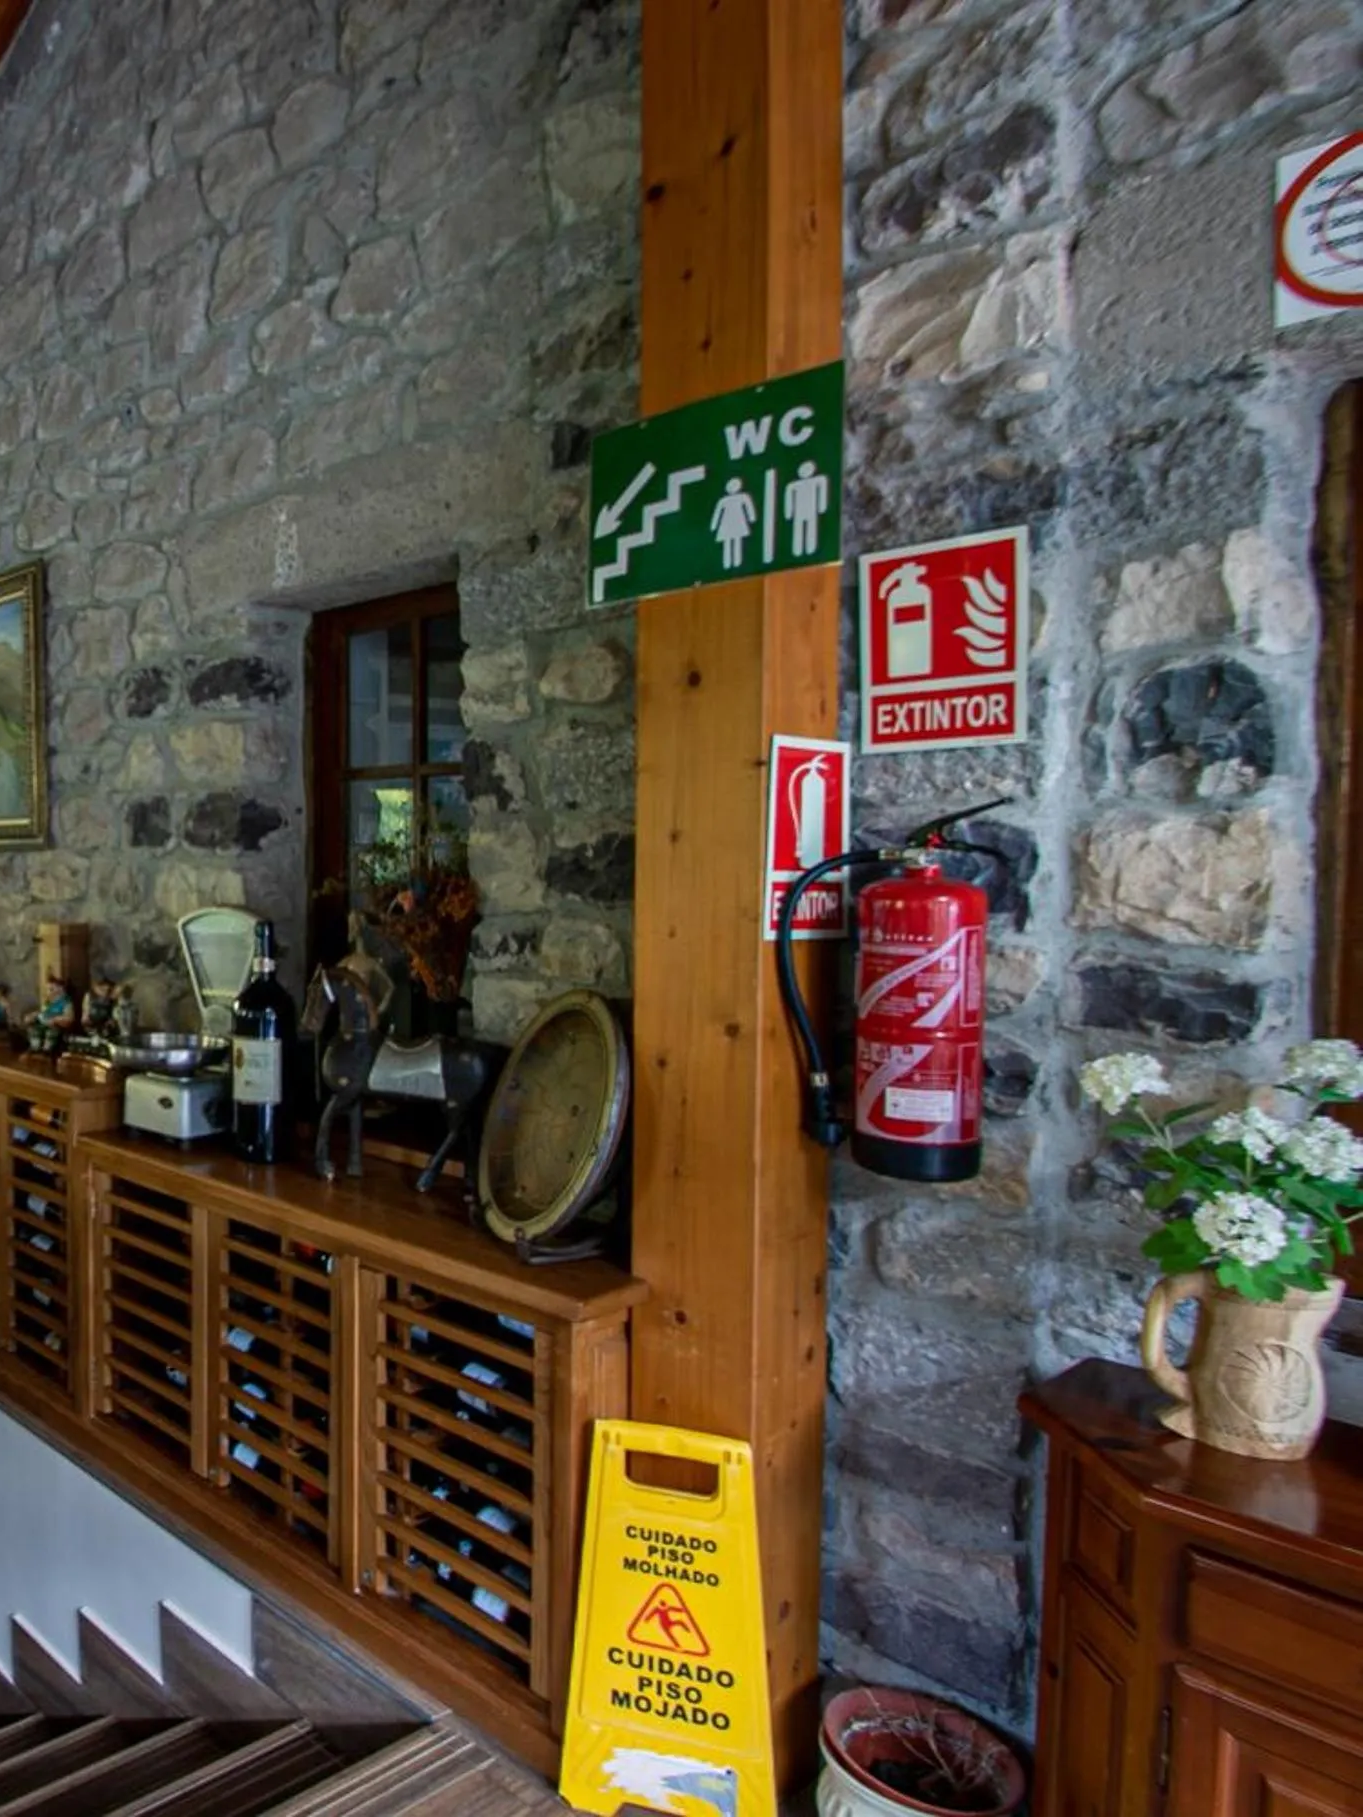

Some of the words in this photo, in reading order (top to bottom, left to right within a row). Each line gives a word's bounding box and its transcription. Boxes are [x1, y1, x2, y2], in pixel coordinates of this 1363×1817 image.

[725, 405, 813, 459] WC
[877, 693, 1007, 735] EXTINTOR
[625, 1525, 717, 1554] CUIDADO
[647, 1545, 694, 1565] PISO
[623, 1557, 719, 1587] MOLHADO
[608, 1647, 735, 1689] CUIDADO
[638, 1676, 703, 1705] PISO
[611, 1689, 730, 1731] MOJADO
